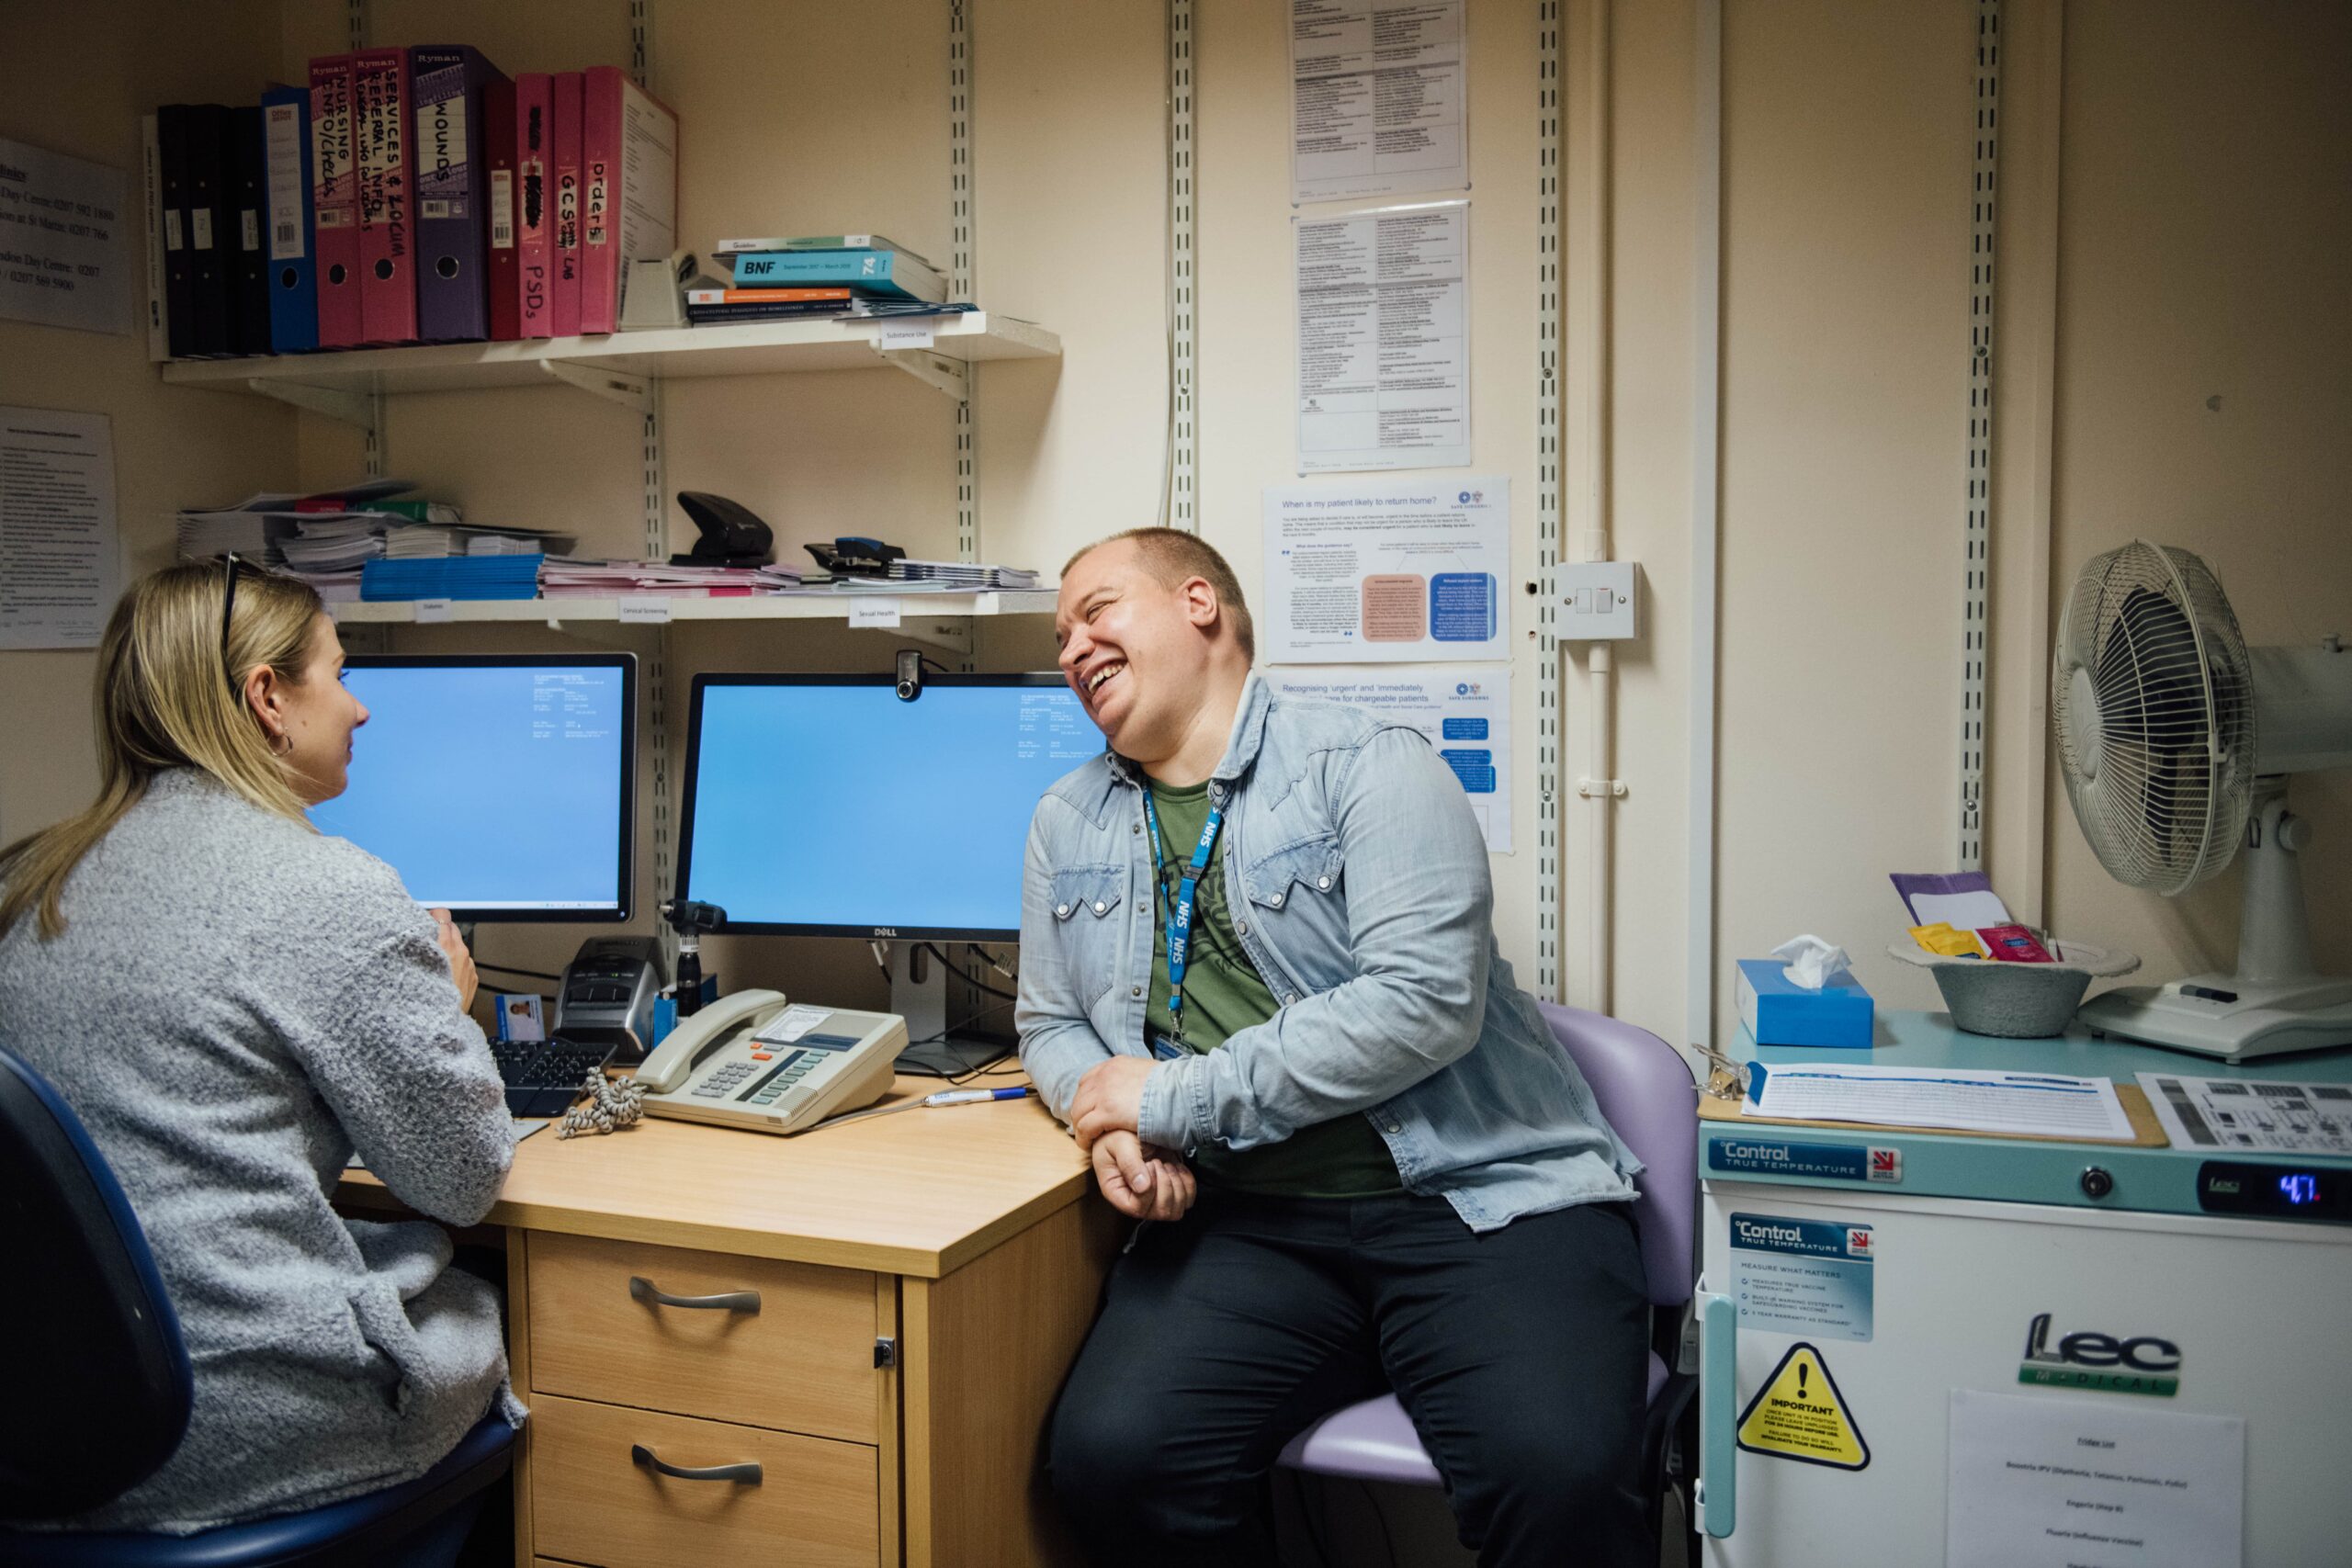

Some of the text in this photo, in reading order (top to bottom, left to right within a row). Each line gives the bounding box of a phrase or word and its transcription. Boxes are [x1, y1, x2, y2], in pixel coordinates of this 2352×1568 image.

[356, 58, 396, 69] Ryman
[418, 54, 460, 62] Ryman
[312, 65, 347, 75] Ryman
[335, 76, 349, 160] NURSING
[386, 71, 398, 164] SERVICES
[435, 102, 449, 182] WOUNDS
[371, 166, 383, 212] INFO
[77, 264, 100, 277] 0207
[744, 261, 776, 275] BNF
[863, 256, 876, 276] 74
[887, 331, 915, 340] Substance
[1306, 500, 1312, 508] is
[1314, 501, 1325, 509] my
[1327, 499, 1353, 509] patient
[1354, 499, 1374, 508] likely
[1385, 498, 1408, 506] return
[1409, 496, 1437, 505] home?
[643, 607, 668, 616] Screening
[879, 609, 896, 617] Health
[1283, 683, 1329, 694] Recognising
[1354, 694, 1397, 704] chargeable
[1398, 694, 1429, 704] patients
[1200, 821, 1216, 848] NHS
[1176, 900, 1191, 930] NHS
[874, 928, 898, 937] DELL
[1172, 937, 1186, 965] NHS
[1725, 1158, 1857, 1175] TRUE TEMPERATURE
[1740, 1236, 1766, 1246] TRUE
[1769, 1240, 1838, 1253] TEMPERATURE
[1741, 1262, 1841, 1279] MEASURE WHAT MATTERS
[1752, 1284, 1793, 1293] TEMPERATURE
[1774, 1314, 1807, 1322] WARRANTY
[2024, 1313, 2181, 1371] Lec
[1770, 1398, 1835, 1416] IMPORTANT
[1764, 1414, 1838, 1431] PLEASE LEAVE UNPLUGGED
[1811, 1416, 1838, 1426] POSITION
[1783, 1423, 1804, 1431] HOURS
[1804, 1426, 1826, 1435] BEFORE
[1760, 1434, 1792, 1445] INVALIDATE
[1793, 1438, 1809, 1447] YOUR
[1769, 1429, 1792, 1438] FAILURE
[1820, 1438, 1834, 1446] WILL
[2101, 1439, 2115, 1450] List
[2006, 1461, 2037, 1472] Boostrix
[2038, 1464, 2052, 1472] IPV
[2094, 1472, 2126, 1483] Tetanus,
[2165, 1479, 2188, 1490] Polio)
[2096, 1502, 2114, 1513] (Hep
[2115, 1504, 2124, 1514] B)
[2111, 1537, 2144, 1548] Vaccine)
